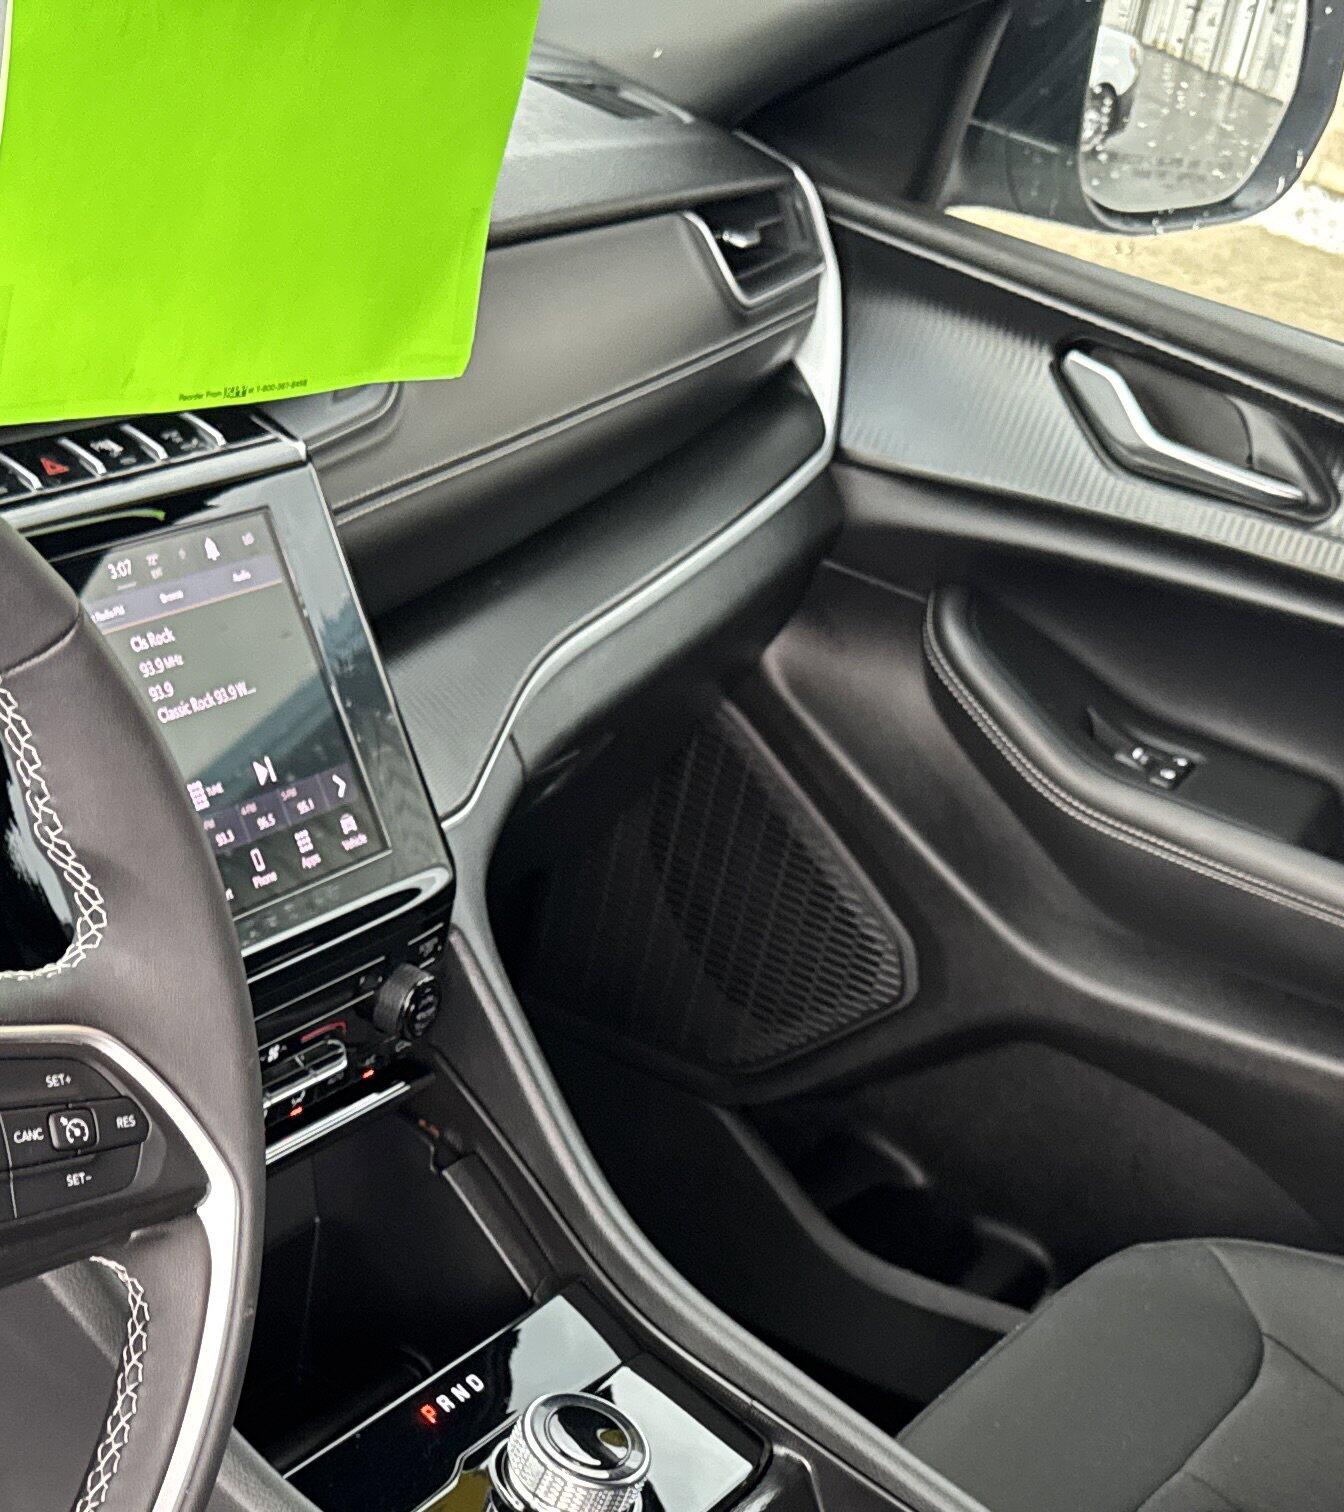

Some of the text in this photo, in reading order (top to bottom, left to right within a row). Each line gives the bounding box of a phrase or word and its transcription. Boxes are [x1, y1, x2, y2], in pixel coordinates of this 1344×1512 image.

[147, 626, 176, 648] Rock
[139, 657, 165, 678] 93.9
[148, 680, 174, 702] 93.9
[157, 700, 192, 723] Classic
[190, 692, 217, 713] Rock
[115, 1114, 136, 1129] RES
[13, 1127, 45, 1144] CANC
